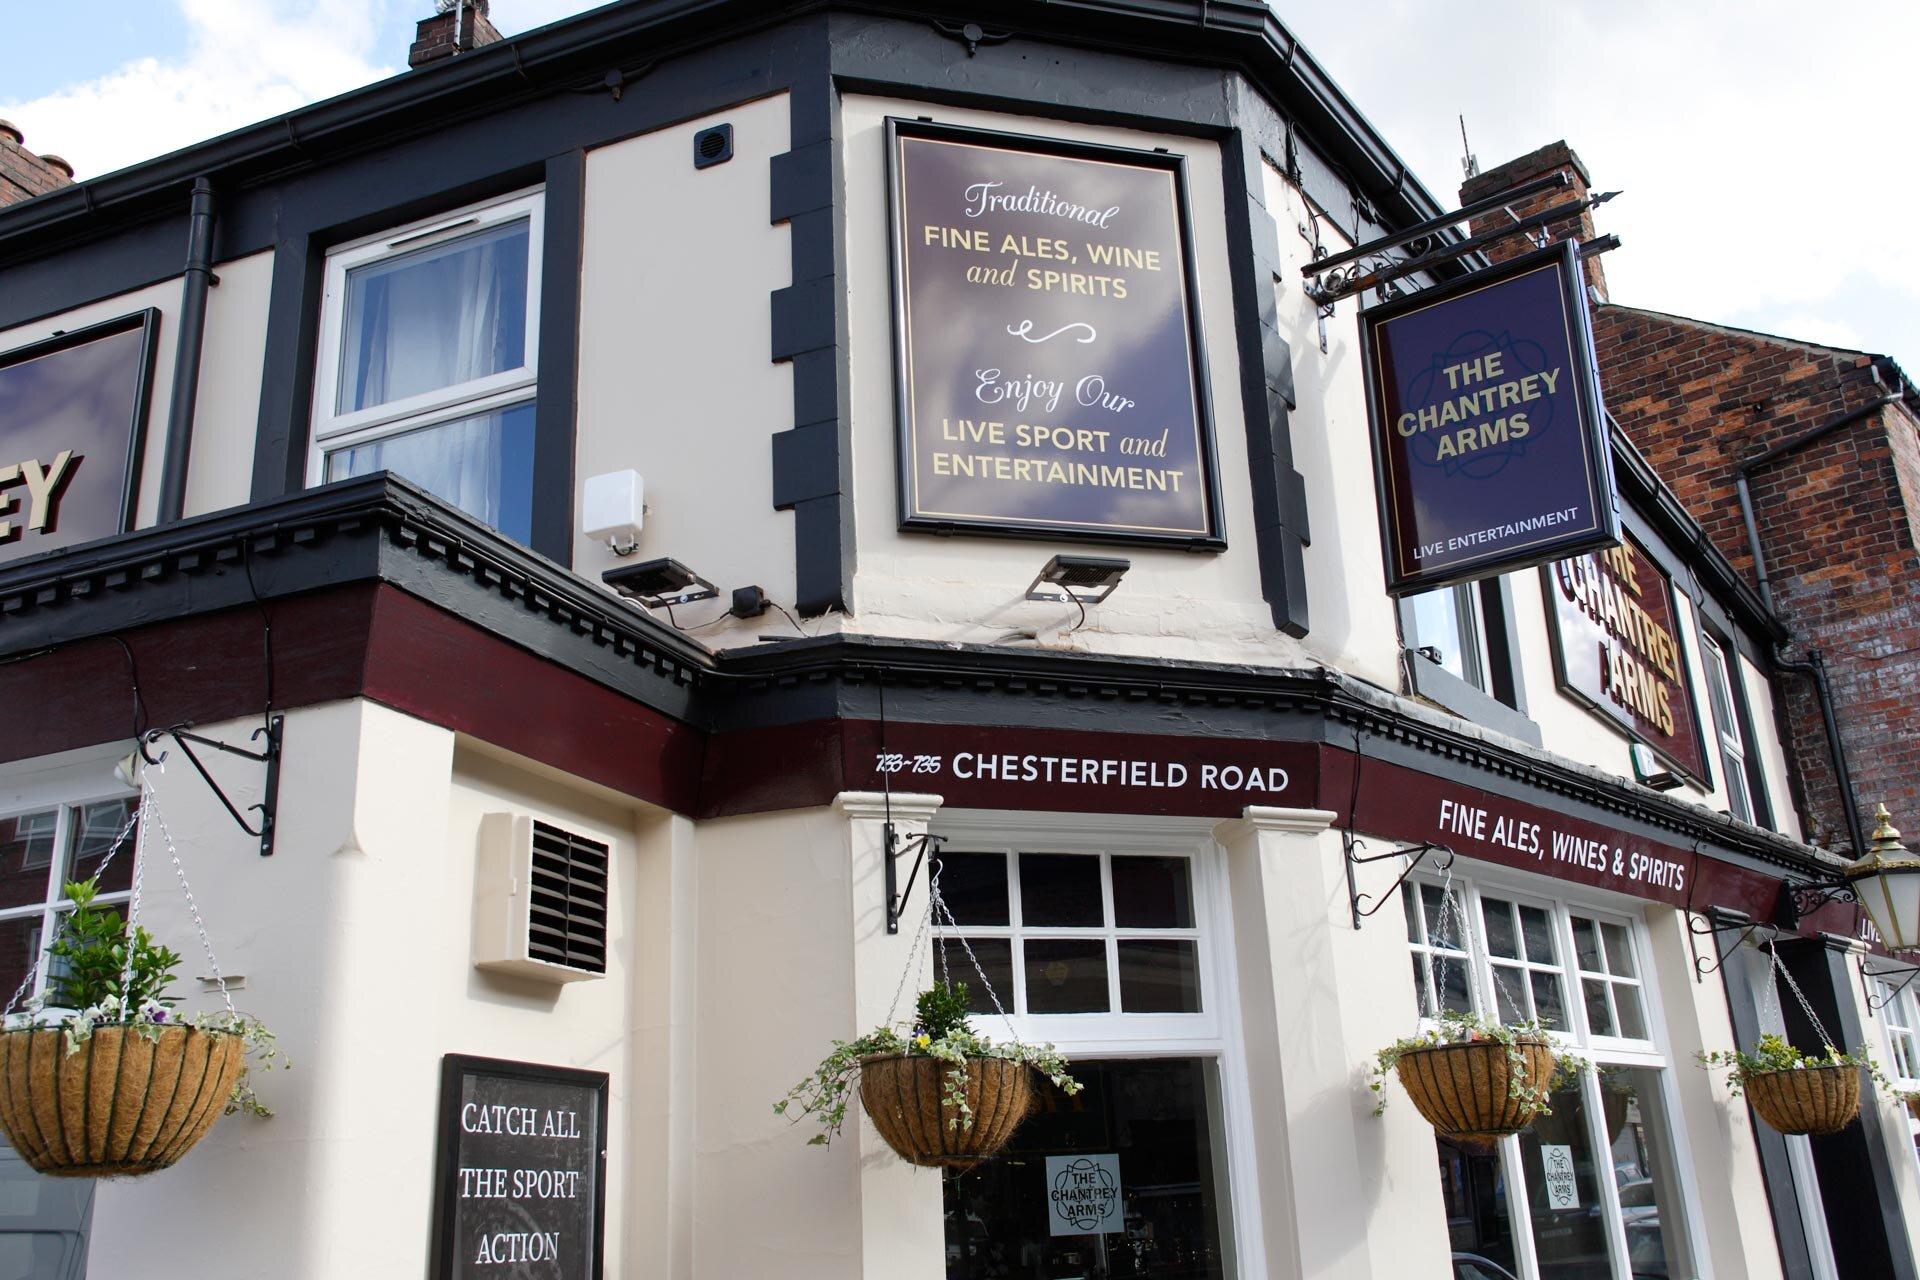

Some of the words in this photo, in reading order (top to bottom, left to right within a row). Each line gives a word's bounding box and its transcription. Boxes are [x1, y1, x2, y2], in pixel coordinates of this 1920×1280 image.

[965, 181, 1120, 230] Traditional
[924, 225, 991, 252] FINE
[1000, 234, 1078, 265] ALES,
[1086, 243, 1161, 271] WINE
[966, 260, 1018, 288] and
[1027, 269, 1127, 299] SPIRITS
[974, 368, 1066, 412] Enjoy
[1075, 374, 1135, 413] Our
[1443, 352, 1504, 390] THE
[1397, 368, 1561, 437] CHANTREY
[942, 420, 1006, 445] LIVE
[1015, 424, 1110, 452] SPORT
[1119, 428, 1169, 458] and
[1436, 413, 1530, 461] ARMS
[932, 452, 1184, 492] ENTERTAINMENT
[1413, 542, 1444, 561] LIVE
[1448, 507, 1579, 551] ENTERTAINMENT
[1610, 639, 1675, 737] ARMS
[951, 752, 1188, 789] CHESTERFIELD
[1200, 765, 1289, 793] ROAD
[1438, 799, 1488, 841] FINE
[1491, 815, 1545, 860] ALES,
[1552, 830, 1608, 872] WINES
[1611, 848, 1624, 876] &
[1629, 852, 1685, 891] SPIRITS
[461, 1102, 538, 1136] CATCH
[541, 1110, 581, 1139] ALL
[459, 1168, 508, 1199] THE
[512, 1169, 579, 1199] SPORT
[1051, 1187, 1118, 1201] CHANTREY
[1072, 1172, 1097, 1185] THE
[1067, 1204, 1106, 1217] ARMS
[475, 1232, 560, 1265] ACTION
